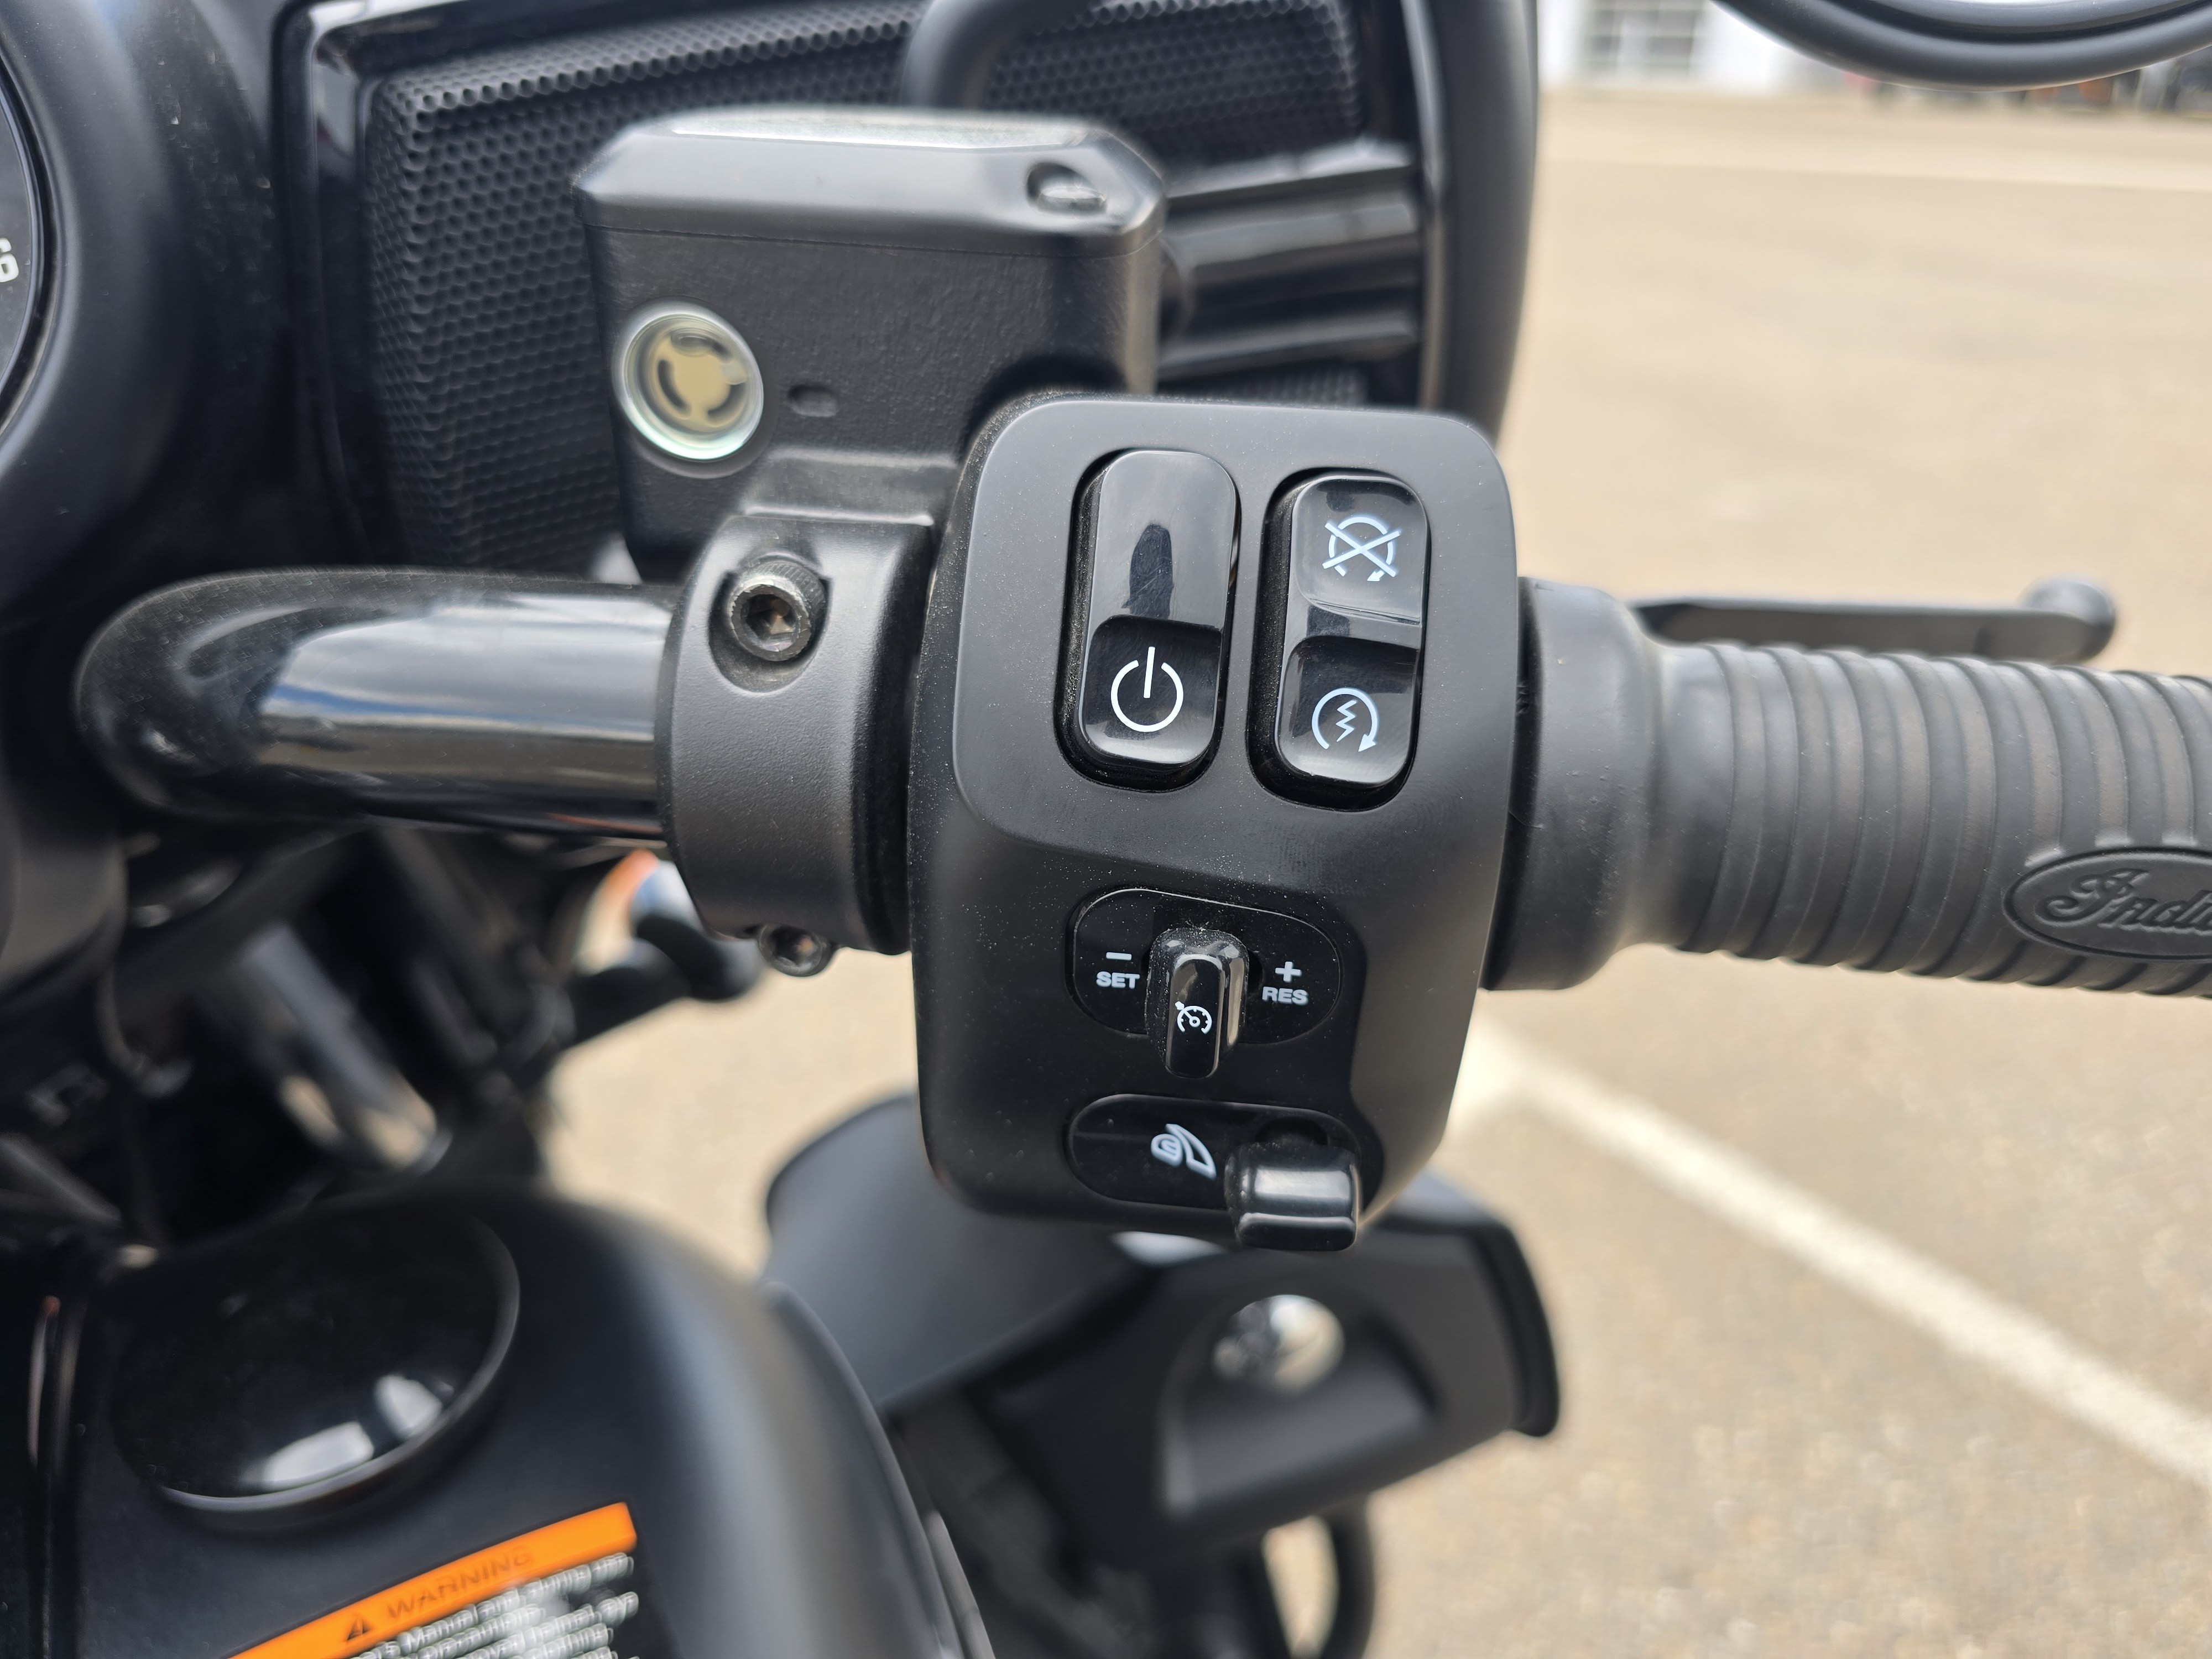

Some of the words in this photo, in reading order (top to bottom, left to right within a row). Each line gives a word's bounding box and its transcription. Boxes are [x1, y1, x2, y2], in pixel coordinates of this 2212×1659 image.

[1096, 971, 1141, 989] SET
[1262, 986, 1308, 1005] RES
[388, 1546, 533, 1619] WARNING
